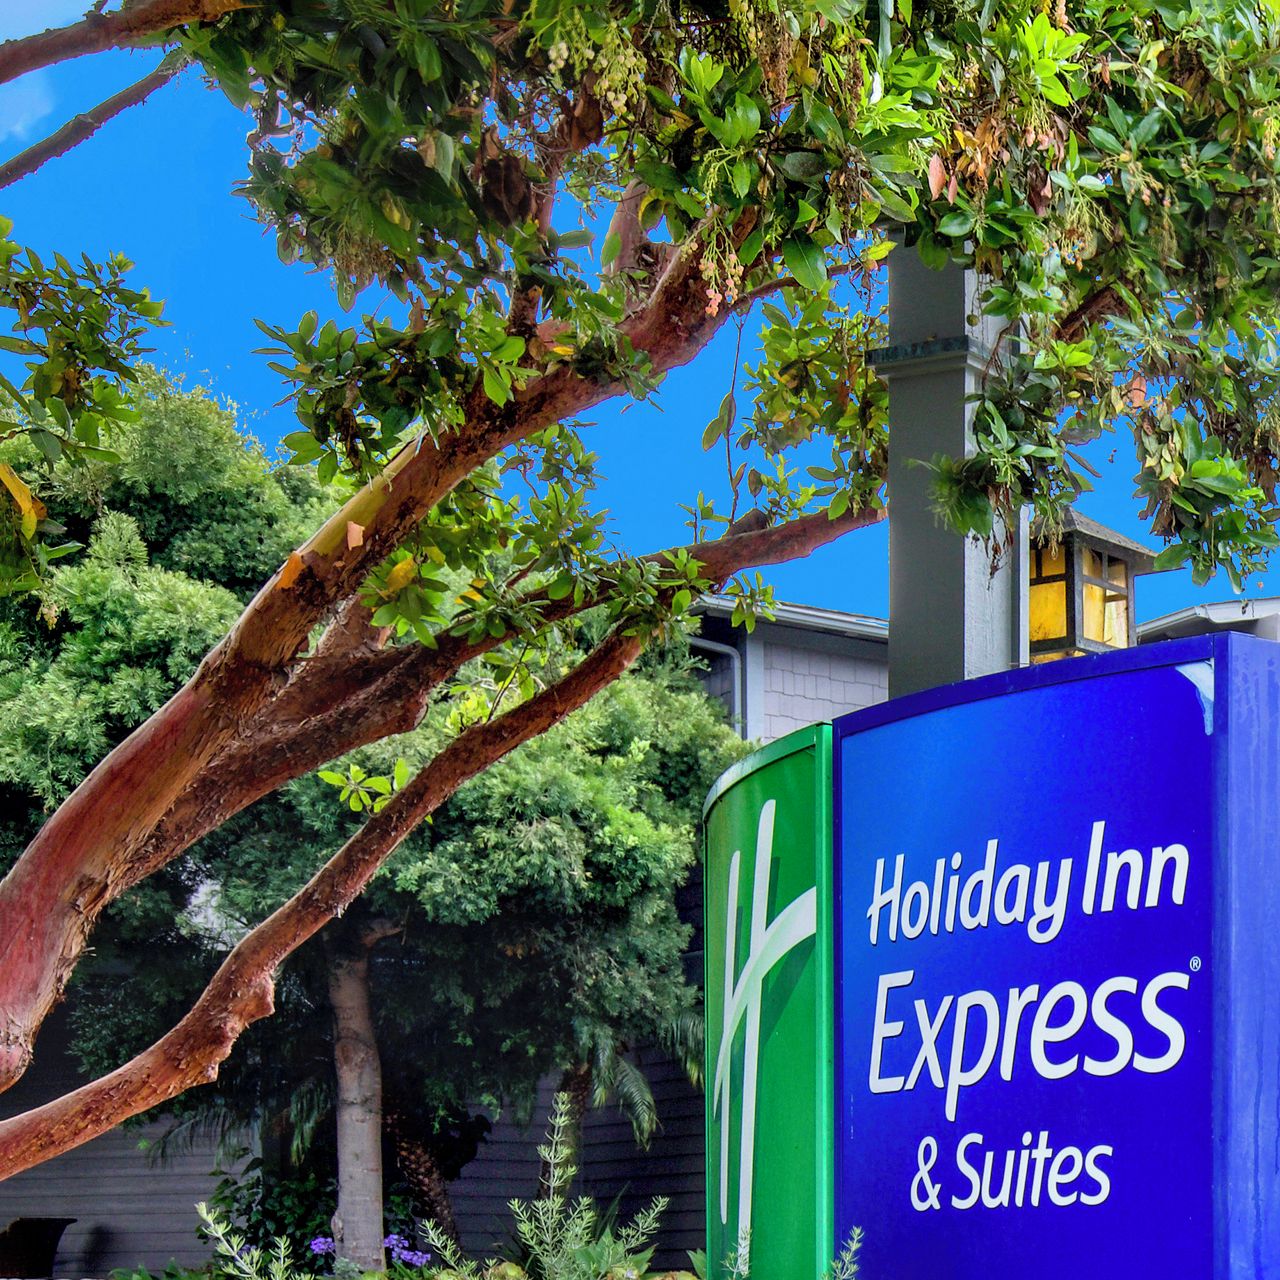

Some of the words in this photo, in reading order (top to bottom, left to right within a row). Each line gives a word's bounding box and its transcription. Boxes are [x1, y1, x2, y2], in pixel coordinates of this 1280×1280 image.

[866, 838, 1073, 945] Holiday
[1082, 820, 1191, 916] Inn
[910, 1135, 942, 1212] &
[951, 1130, 1114, 1209] Suites
